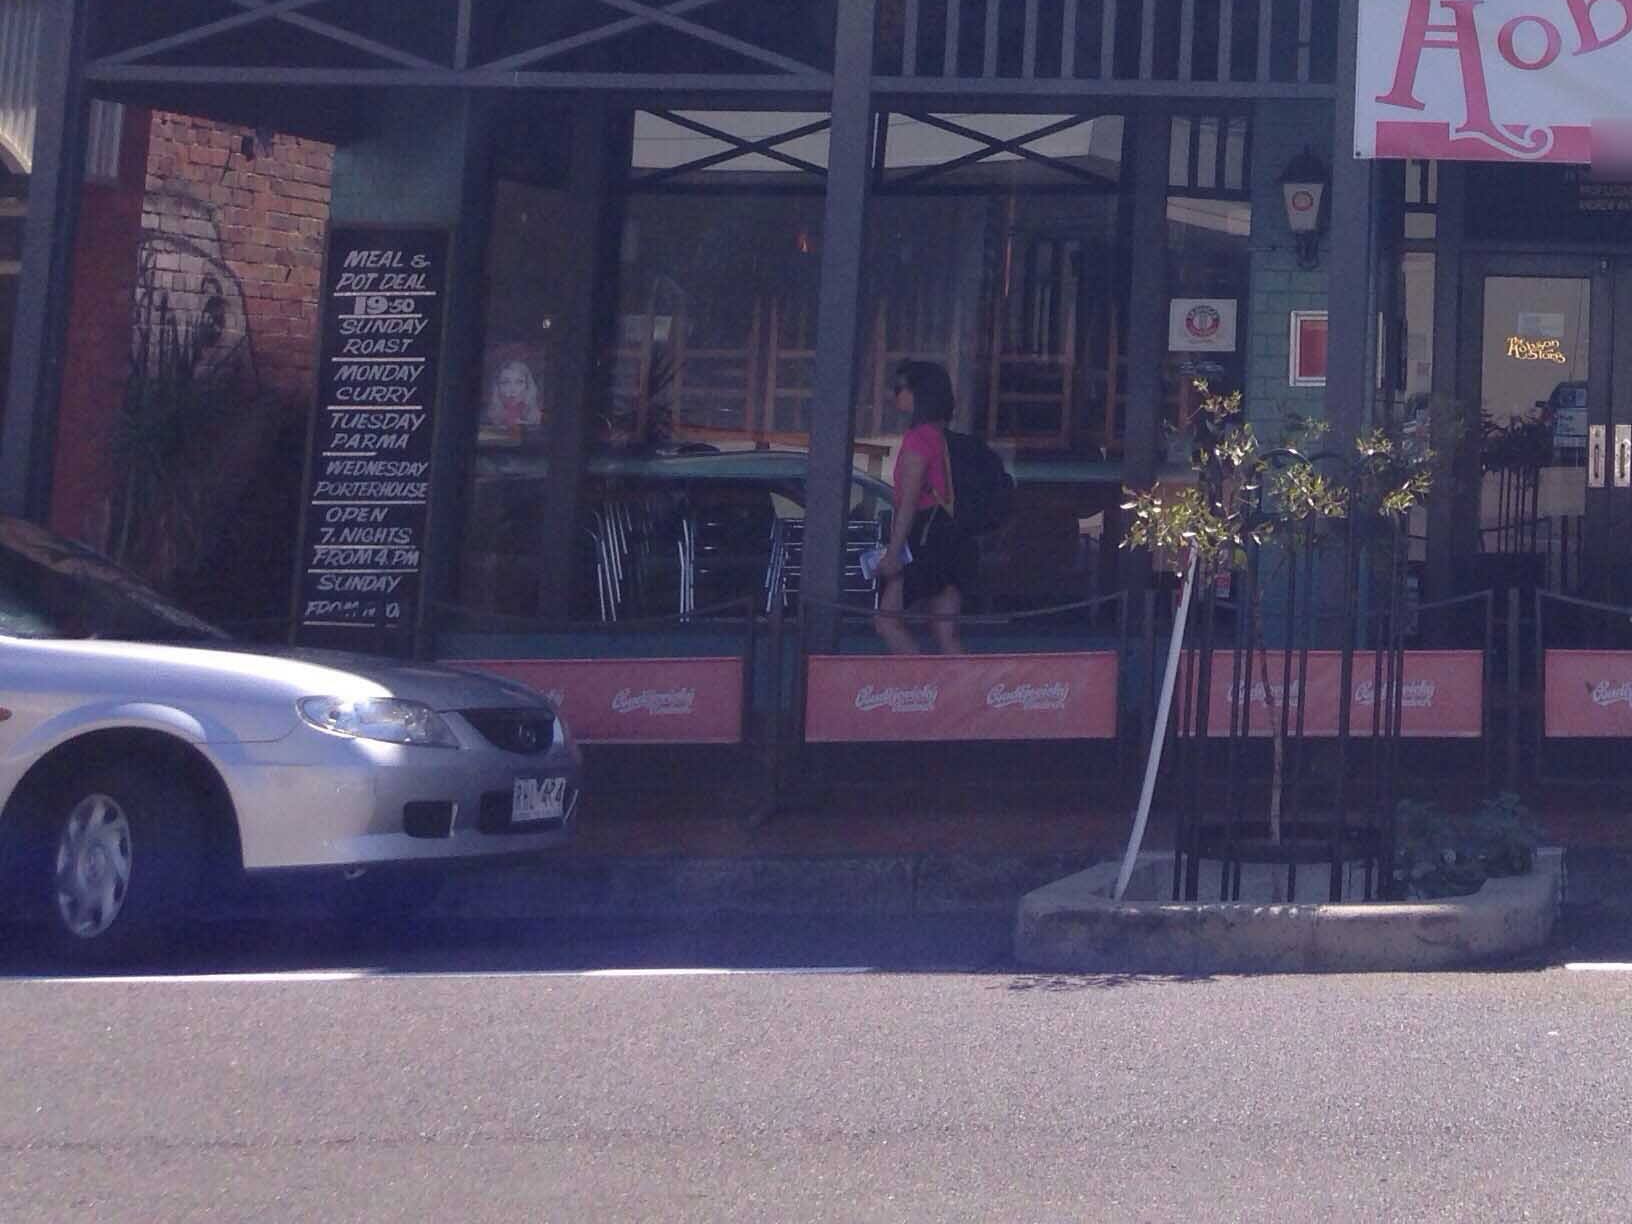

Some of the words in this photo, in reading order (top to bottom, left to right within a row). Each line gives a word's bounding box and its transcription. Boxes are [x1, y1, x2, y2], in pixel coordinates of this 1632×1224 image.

[343, 250, 404, 268] MEAL
[410, 254, 431, 268] &
[335, 272, 379, 290] POT
[379, 273, 426, 289] DEAL
[340, 318, 429, 335] SUNDAY
[342, 338, 414, 355] ROAST
[333, 364, 425, 382] MONDAY
[335, 386, 417, 403] CURRY
[329, 412, 427, 431] TUESDAY
[330, 433, 410, 449] PARMA
[325, 460, 429, 477] WEDNESDAY
[313, 481, 429, 498] PORTERHOUSE
[325, 506, 389, 522] OPEN
[312, 549, 372, 566] FROM
[316, 575, 402, 593] SUNDAY
